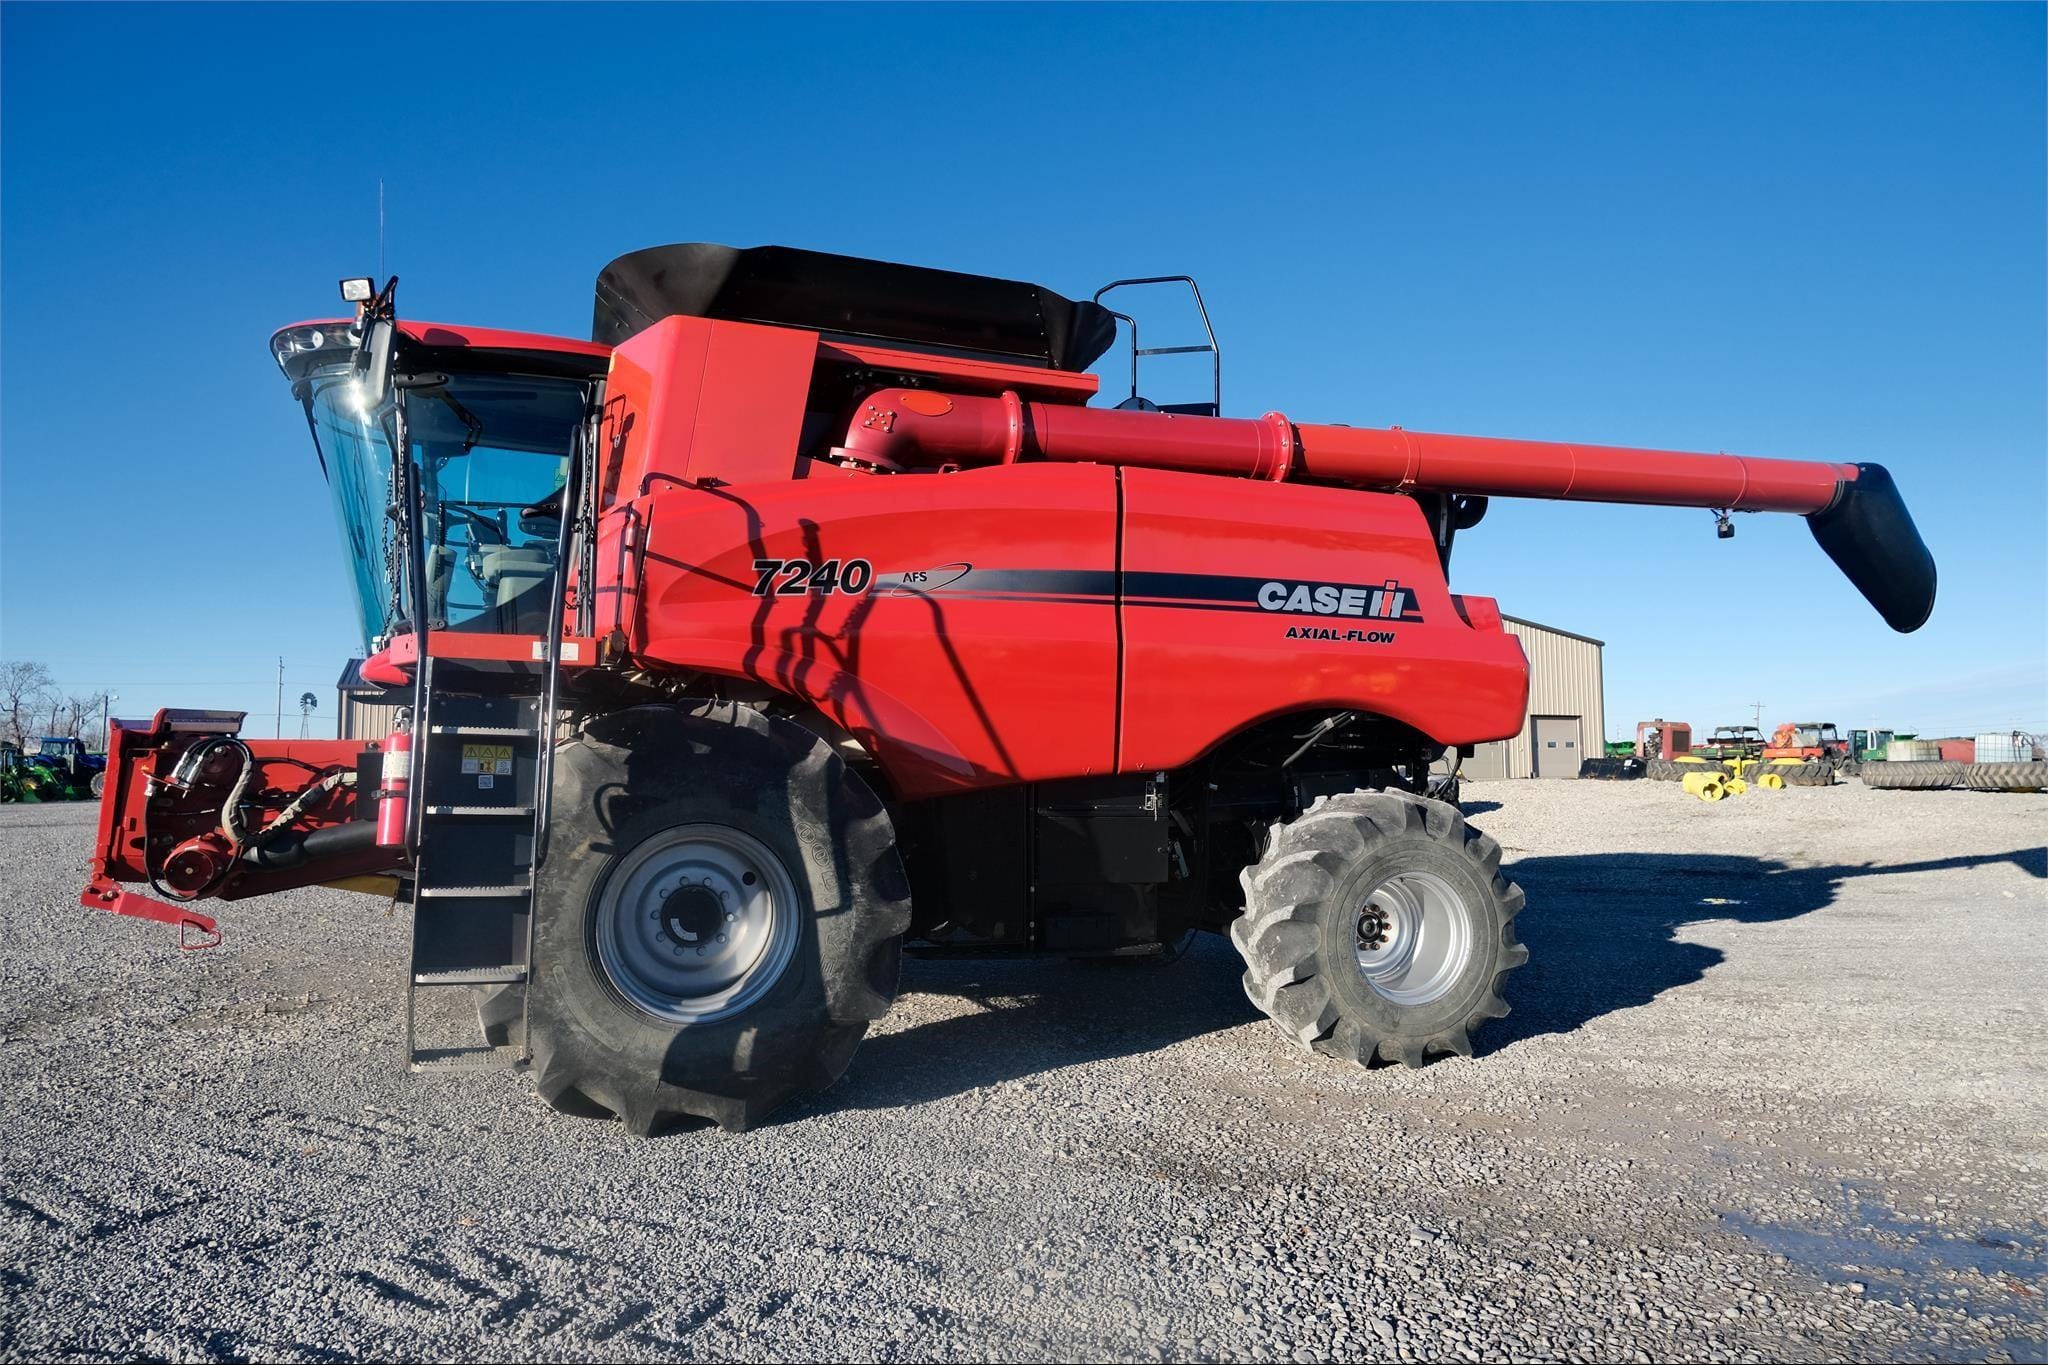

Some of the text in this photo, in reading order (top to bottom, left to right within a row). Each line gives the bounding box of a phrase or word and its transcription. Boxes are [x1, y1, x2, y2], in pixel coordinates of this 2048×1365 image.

[753, 559, 871, 597] 7240
[902, 572, 928, 583] AFS
[1257, 582, 1366, 616] CASE
[1286, 627, 1396, 643] AXIAL-FLOW
